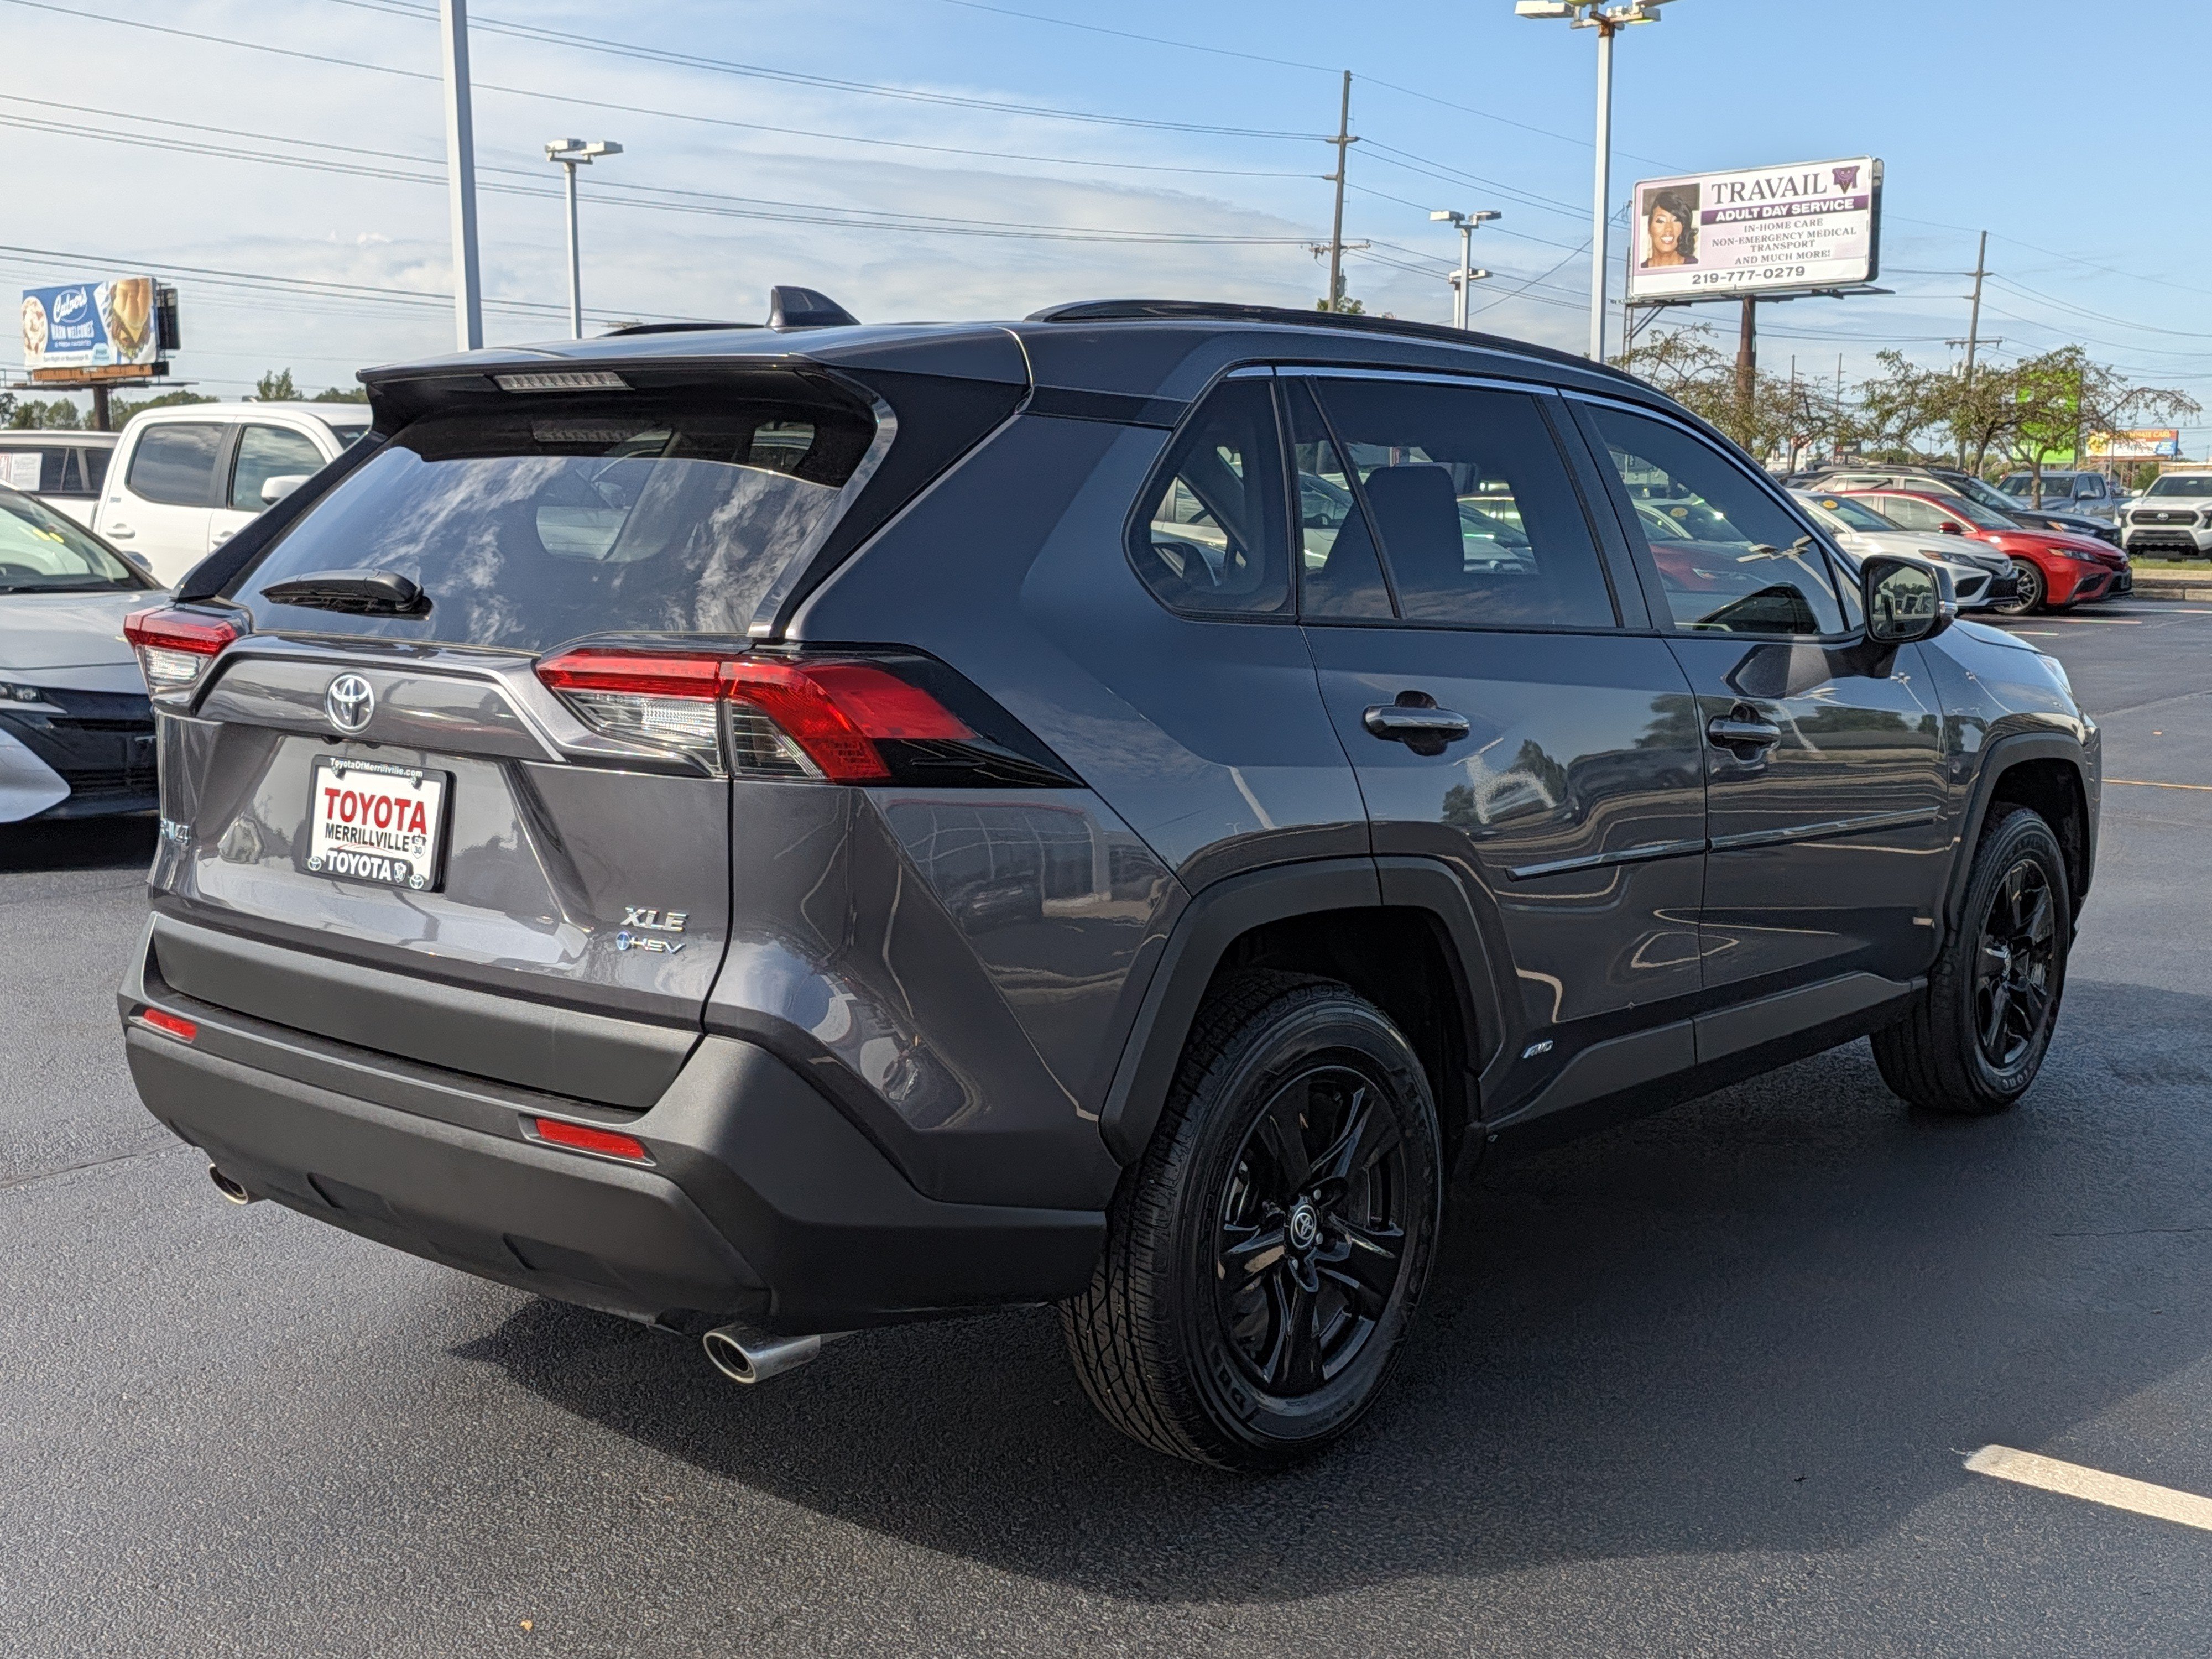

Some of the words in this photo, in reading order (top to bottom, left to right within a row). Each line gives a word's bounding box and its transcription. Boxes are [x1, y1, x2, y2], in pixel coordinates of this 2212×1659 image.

[1711, 173, 1827, 205] TRAVAIL
[1716, 208, 1760, 222] ADULT
[1762, 205, 1790, 217] DAY
[1791, 199, 1854, 215] SERVICE
[1744, 221, 1791, 233] IN-HOME
[1794, 218, 1824, 227] CARE
[1712, 231, 1804, 247] NON-EMERGENCY
[1807, 227, 1857, 239] MEDICAL
[1751, 239, 1815, 252] TRANSPORT
[1735, 255, 1757, 265] AND
[1761, 253, 1792, 263] MUCH
[1692, 265, 1806, 284] 219-777-0279
[330, 757, 423, 778] ToyotaOfMerrillville.com
[325, 787, 427, 835] TOYOTA
[325, 822, 410, 852] MERRILLVILLE
[327, 850, 392, 881] TOYOTA
[620, 906, 689, 932] XLE
